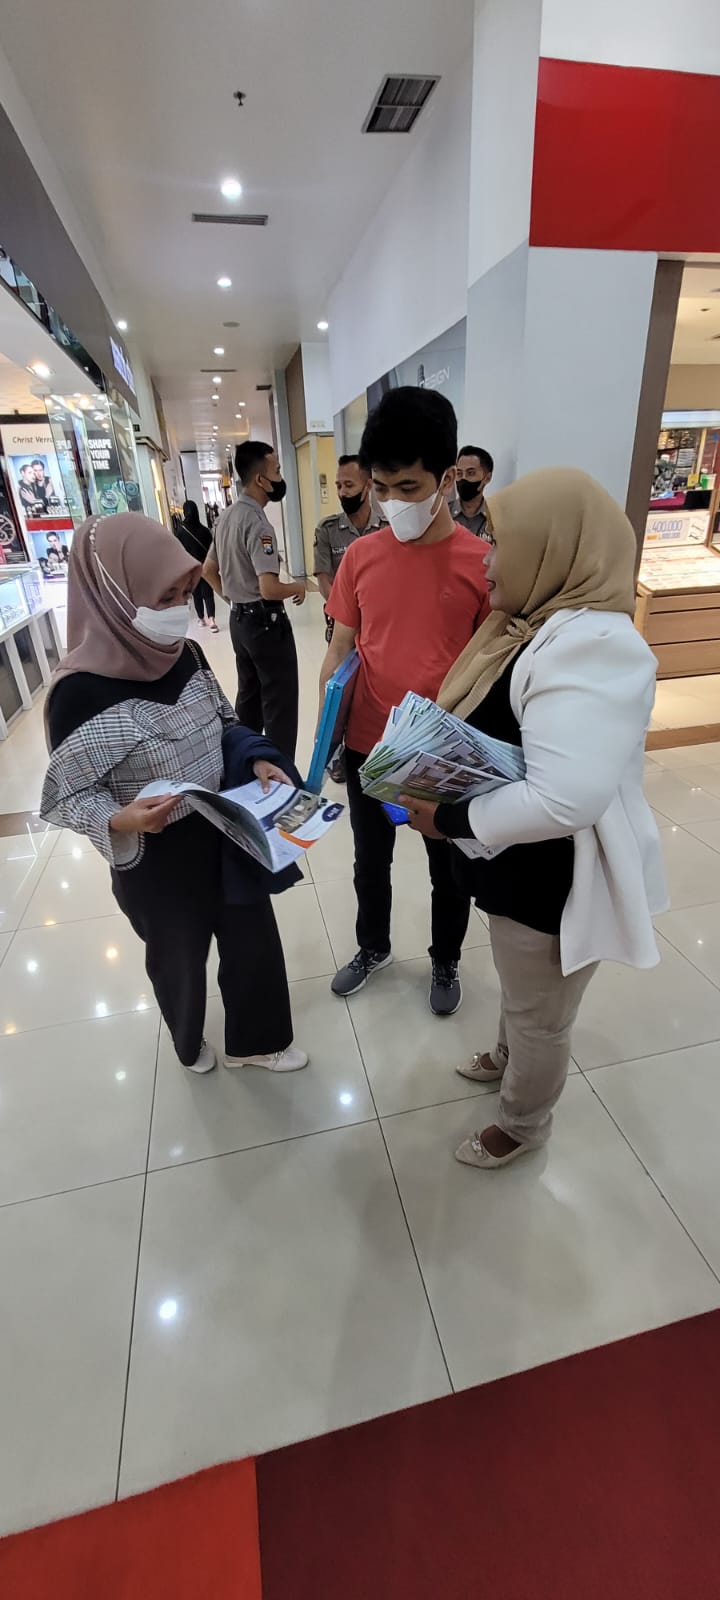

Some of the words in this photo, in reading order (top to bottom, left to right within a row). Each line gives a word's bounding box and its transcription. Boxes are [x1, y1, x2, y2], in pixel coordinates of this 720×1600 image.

[12, 436, 33, 444] Christ
[87, 438, 113, 449] SHAPE
[90, 449, 111, 460] YOUR
[92, 460, 111, 470] TIME
